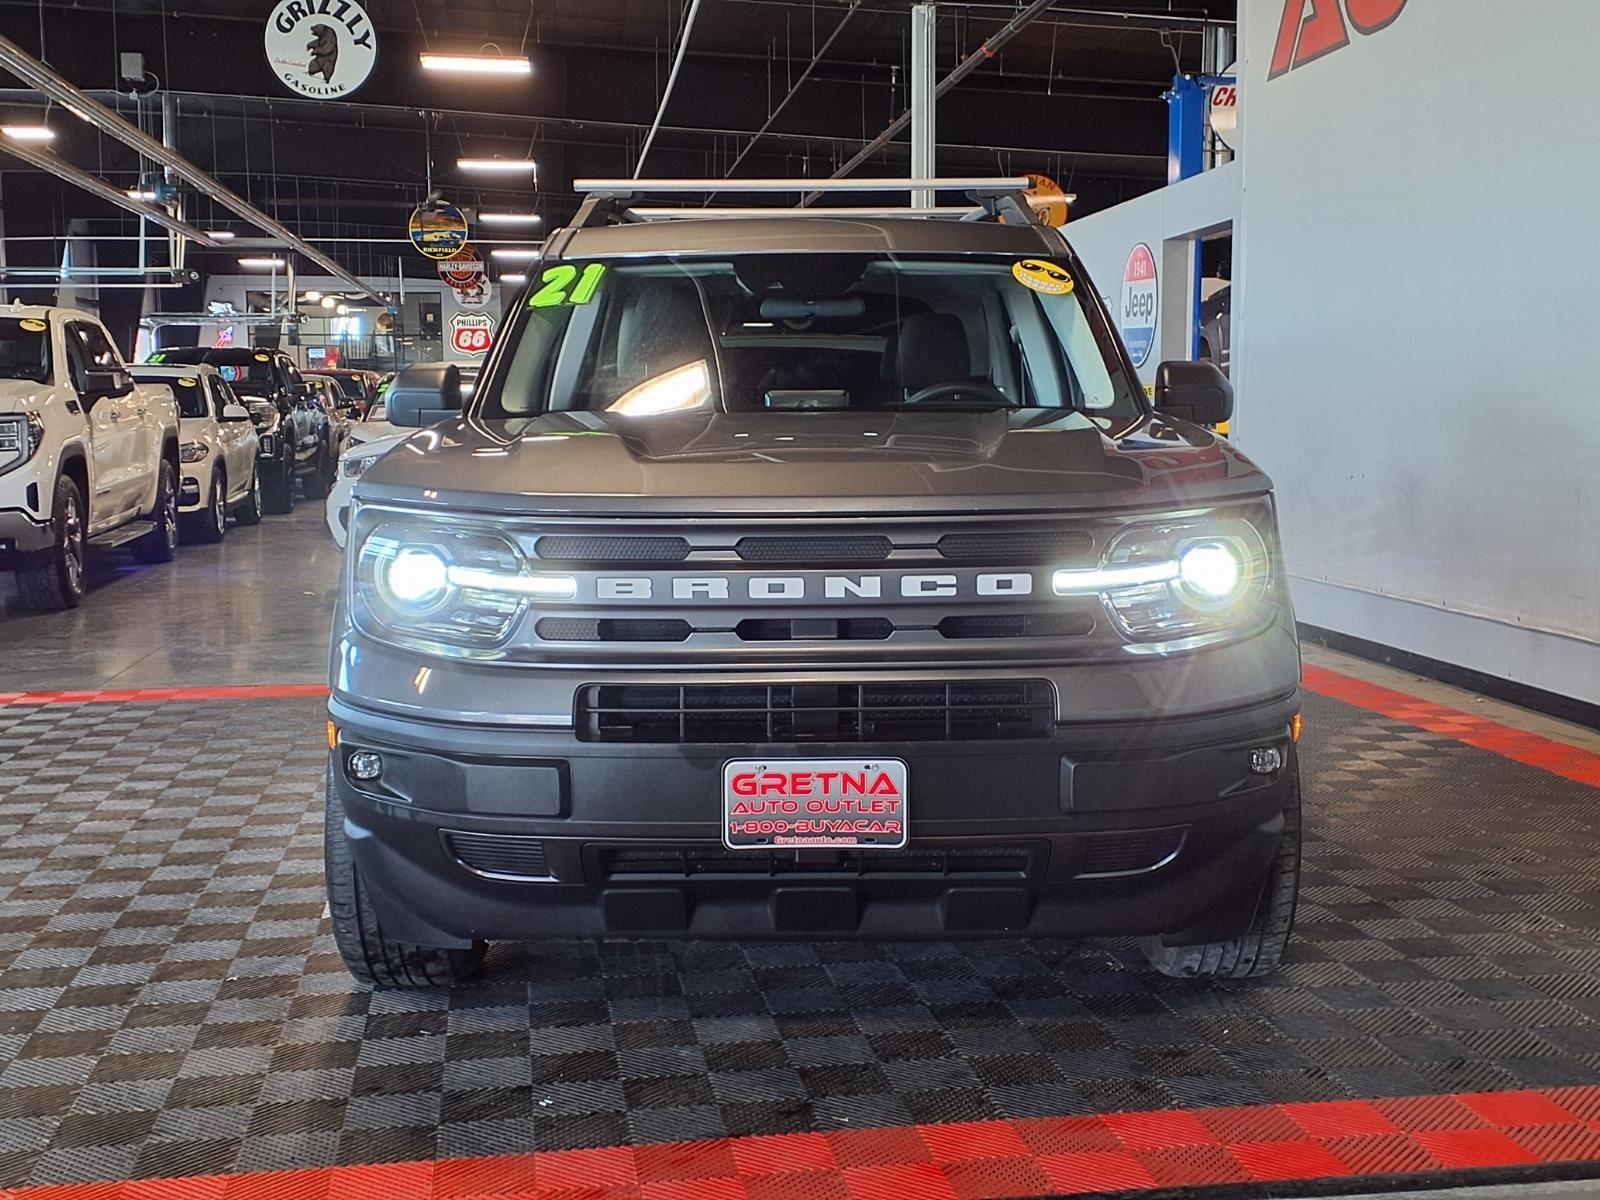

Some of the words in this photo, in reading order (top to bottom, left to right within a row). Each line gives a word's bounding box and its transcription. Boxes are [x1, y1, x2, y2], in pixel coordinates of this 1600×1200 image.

[276, 0, 372, 50] GRIZZLY
[284, 73, 346, 95] GASOLINE
[1133, 261, 1147, 277] 1941
[529, 263, 606, 307] 21
[1125, 287, 1153, 323] Jeep
[456, 319, 487, 327] PHILLIPS
[458, 330, 486, 347] 66
[597, 573, 1032, 599] BRONCO
[731, 770, 901, 797] GRETNA
[730, 799, 799, 814] AUTO
[805, 799, 902, 814] OUTLET
[730, 819, 902, 834] 1-800-BUYACAR
